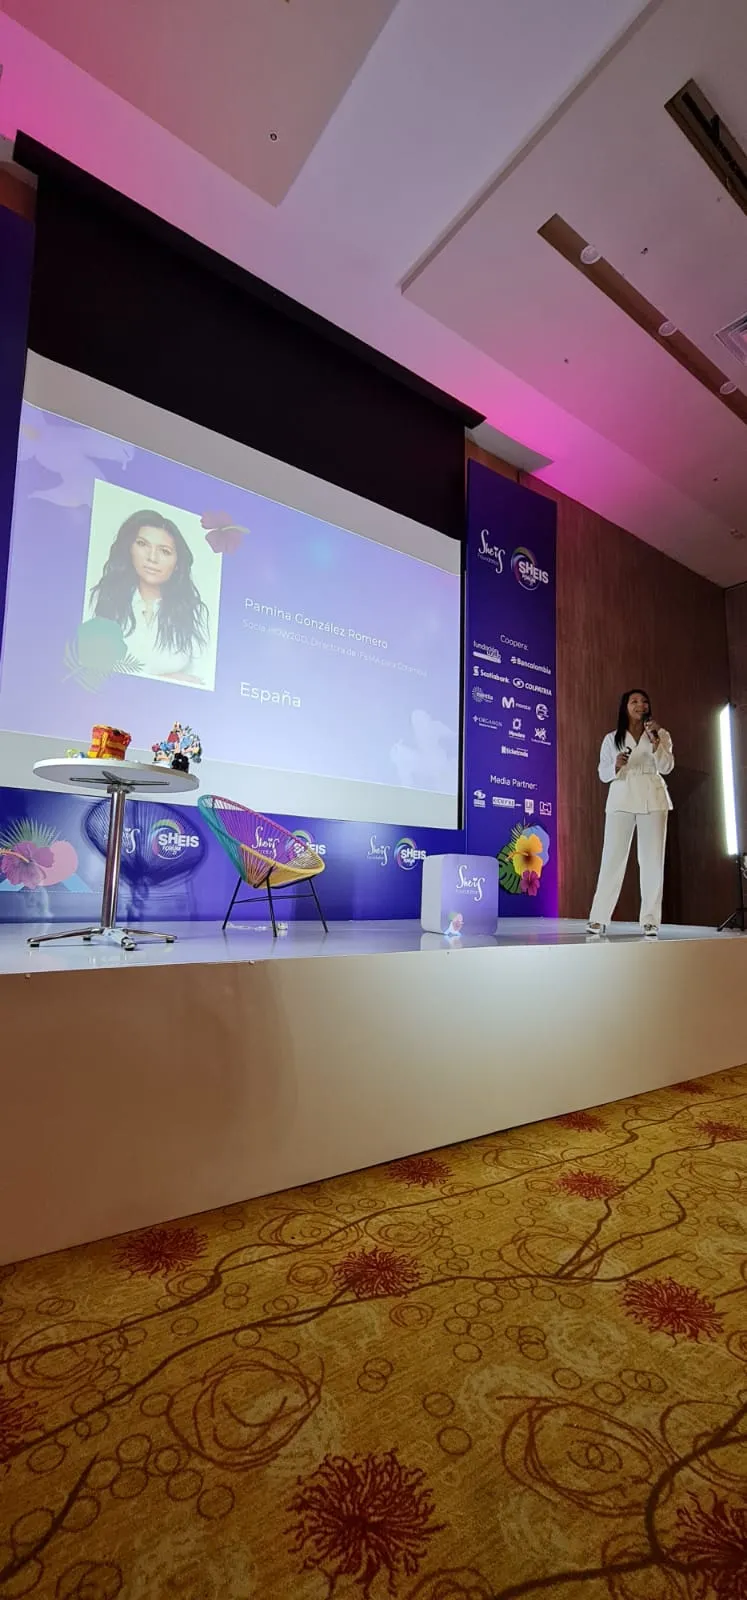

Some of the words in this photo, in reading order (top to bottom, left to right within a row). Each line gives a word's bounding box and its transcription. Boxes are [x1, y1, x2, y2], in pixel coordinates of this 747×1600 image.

[519, 561, 549, 584] SHEIS
[244, 597, 292, 621] Pamina
[295, 612, 345, 637] González
[348, 628, 388, 649] Romero
[517, 657, 552, 675] Bancolombia
[480, 669, 511, 684] Scotiabank
[240, 681, 301, 708] España
[525, 682, 553, 696] COLPATRIA
[490, 775, 511, 786] Media
[512, 779, 538, 791] Partner:
[158, 833, 200, 848] SHEIS
[400, 848, 427, 860] SHEIS
